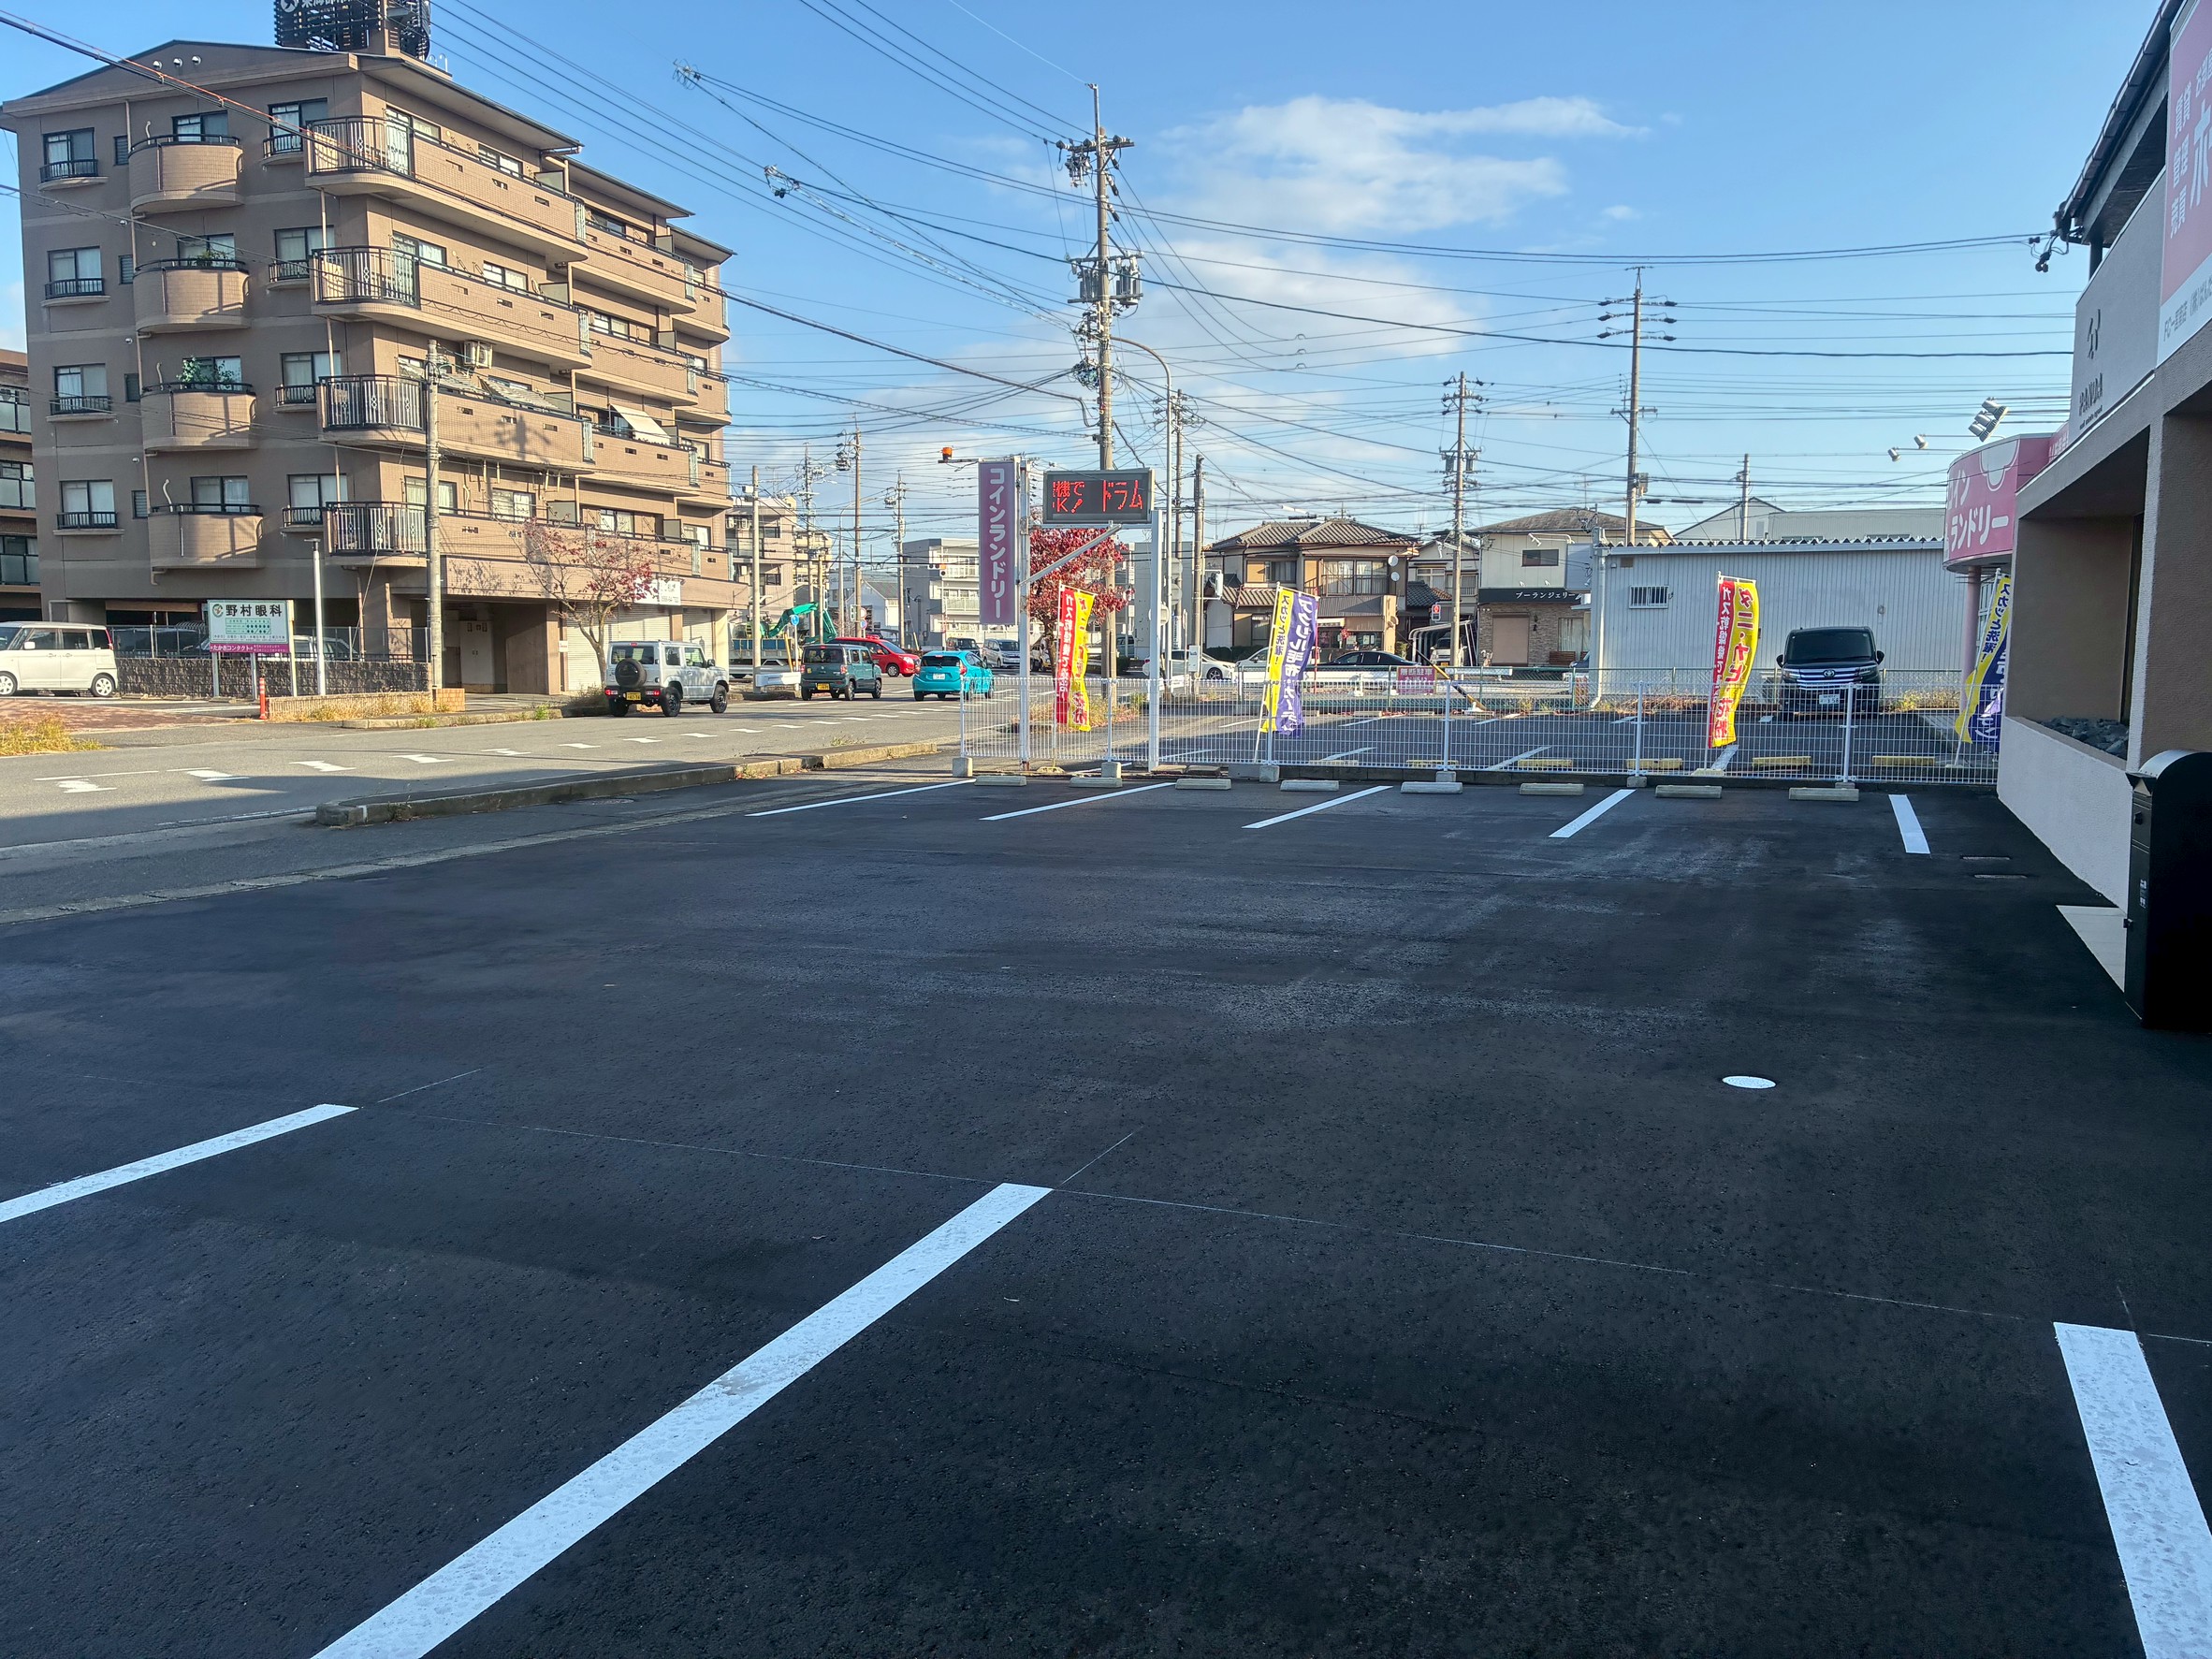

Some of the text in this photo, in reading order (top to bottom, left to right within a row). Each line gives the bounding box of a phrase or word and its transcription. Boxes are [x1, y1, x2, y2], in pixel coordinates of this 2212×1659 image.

[1053, 480, 1084, 497] 機で
[1102, 480, 1143, 512] ドラム
[1053, 497, 1084, 513] K!
[1951, 504, 2009, 552] ランドリー
[989, 468, 1006, 618] コインランドリー
[226, 604, 282, 617] 野村眼科
